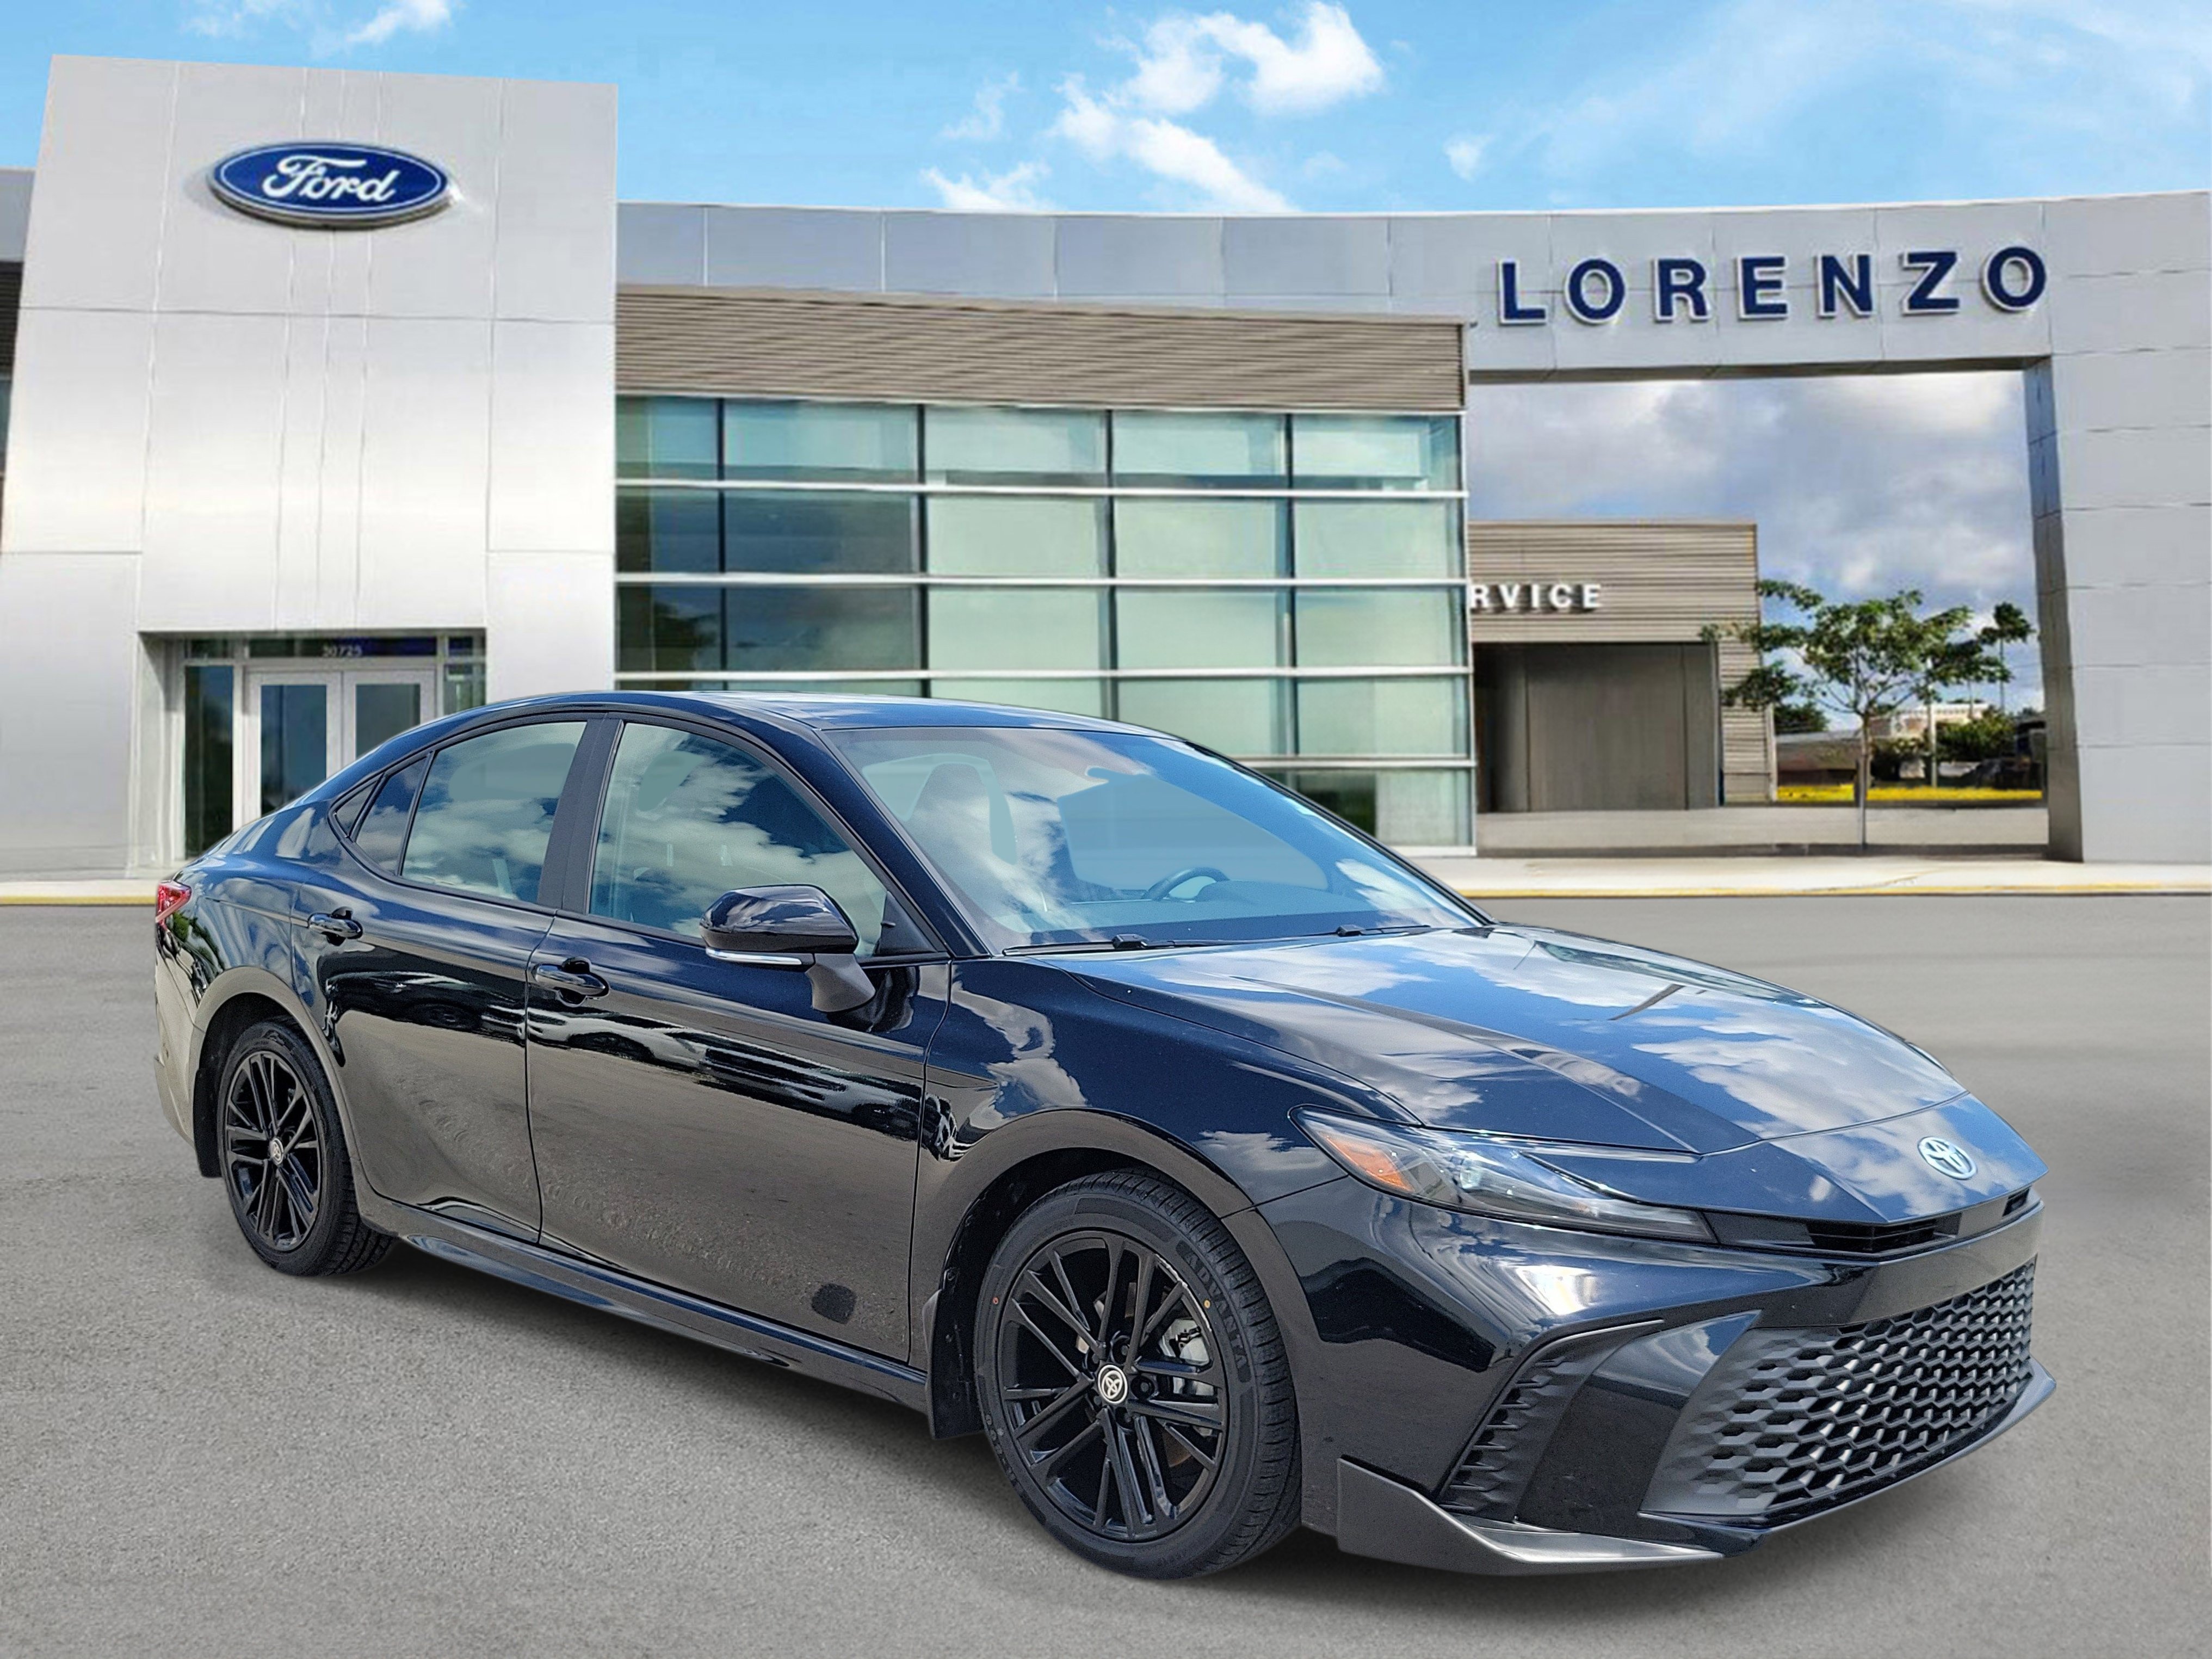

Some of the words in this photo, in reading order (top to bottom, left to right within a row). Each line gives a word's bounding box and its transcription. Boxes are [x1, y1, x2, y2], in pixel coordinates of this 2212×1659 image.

[262, 154, 400, 202] Ford
[1499, 246, 2047, 324] LORENZO
[1470, 584, 1602, 609] RVICE
